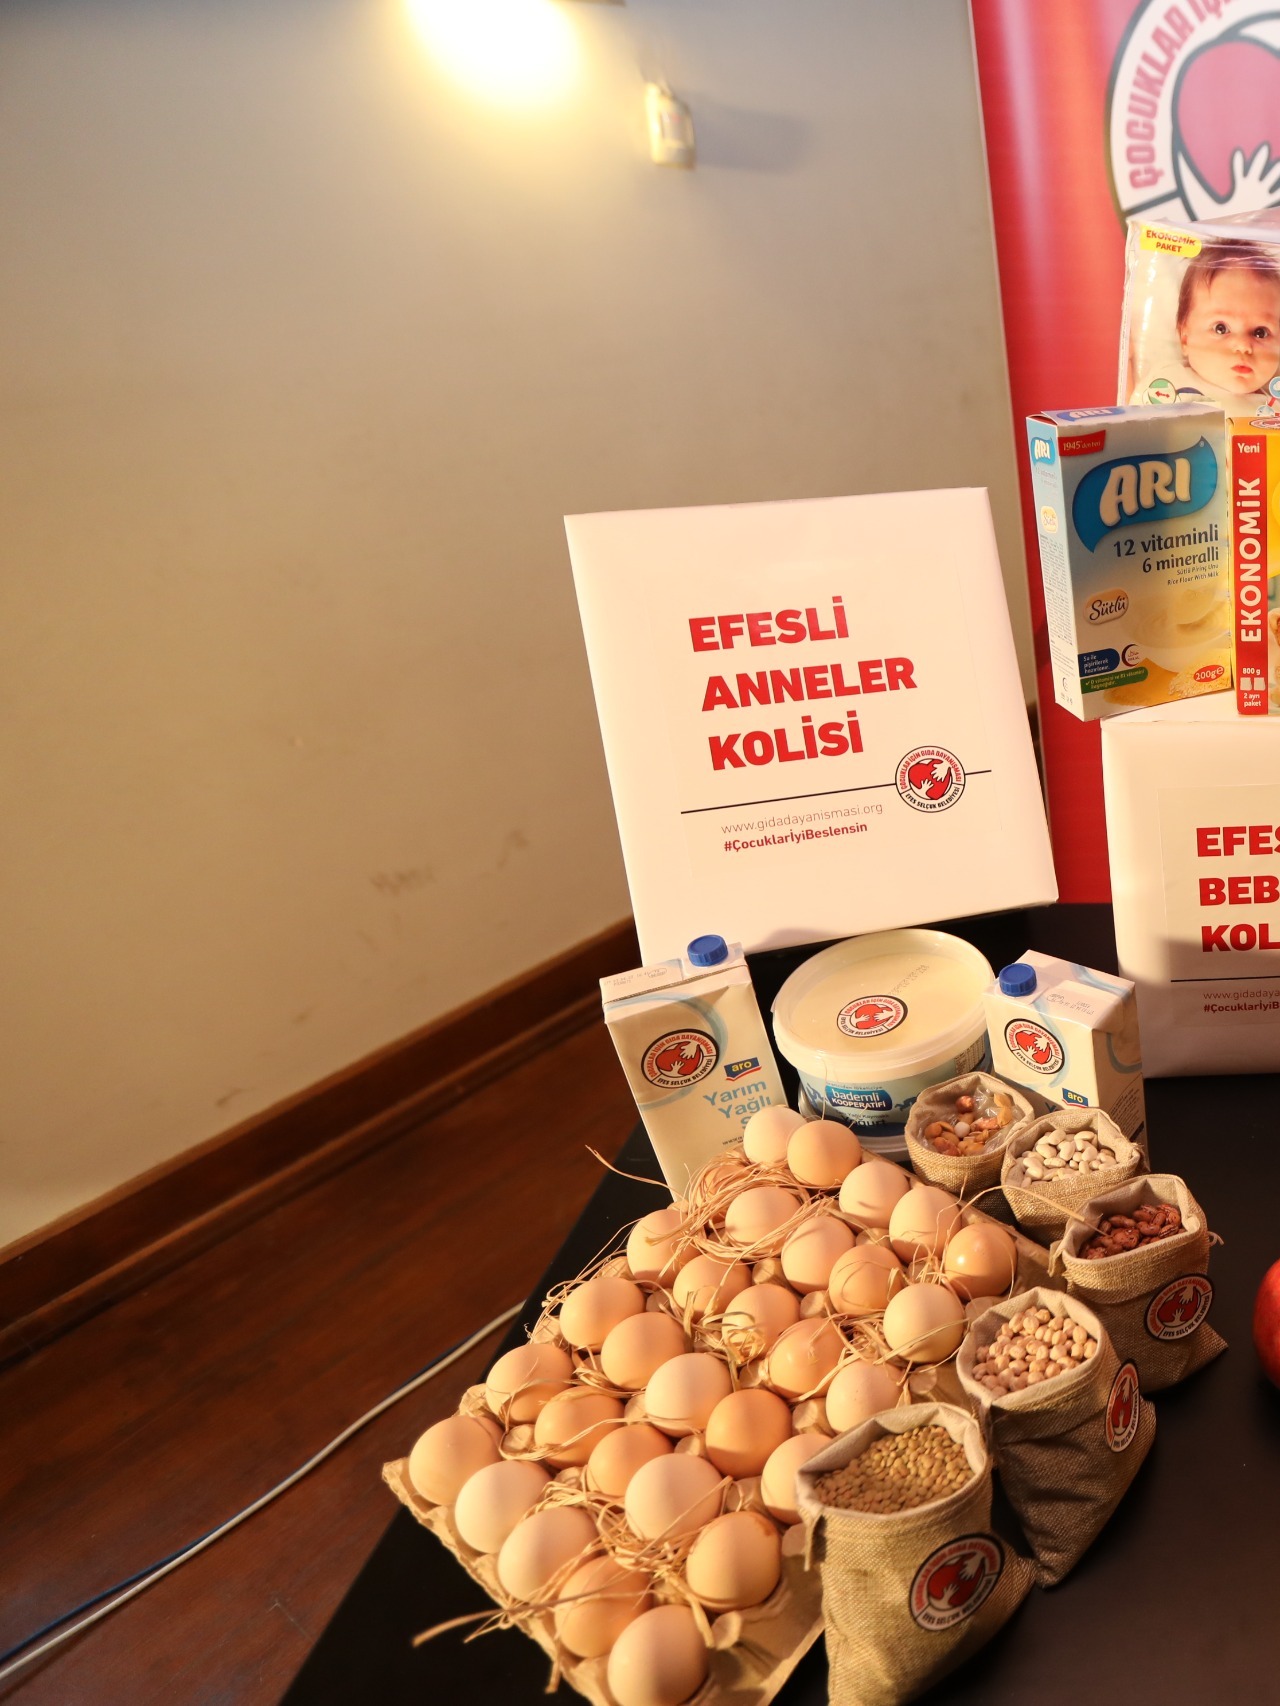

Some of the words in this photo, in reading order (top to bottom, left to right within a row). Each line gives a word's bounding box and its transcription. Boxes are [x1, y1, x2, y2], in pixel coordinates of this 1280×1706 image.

[1126, 5, 1195, 190] ÇOCUKLAR
[1146, 230, 1196, 246] EKONOMİK
[1156, 242, 1182, 253] PAKET
[1237, 442, 1260, 454] Yeni
[1099, 457, 1192, 528] ARI
[1113, 539, 1136, 558] 12
[1140, 523, 1219, 553] vitaminli
[1142, 557, 1152, 573] 6
[1156, 546, 1219, 571] mineralli
[1236, 477, 1262, 643] EKONOMİK
[1089, 595, 1126, 621] Sütlü
[688, 595, 849, 652] EFESLİ
[701, 657, 918, 711] ANNELER
[1242, 667, 1255, 675] 800
[708, 710, 864, 770] KOLİSİ
[721, 803, 883, 834] www.gidadayanismasi.org
[724, 822, 868, 852] #ÇocuklarİyiBeslensin
[731, 1061, 752, 1072] aro
[702, 1081, 767, 1106] Yarım
[832, 1088, 880, 1102] bademli
[1067, 1090, 1084, 1103] aro
[718, 1095, 772, 1119] Yağlı
